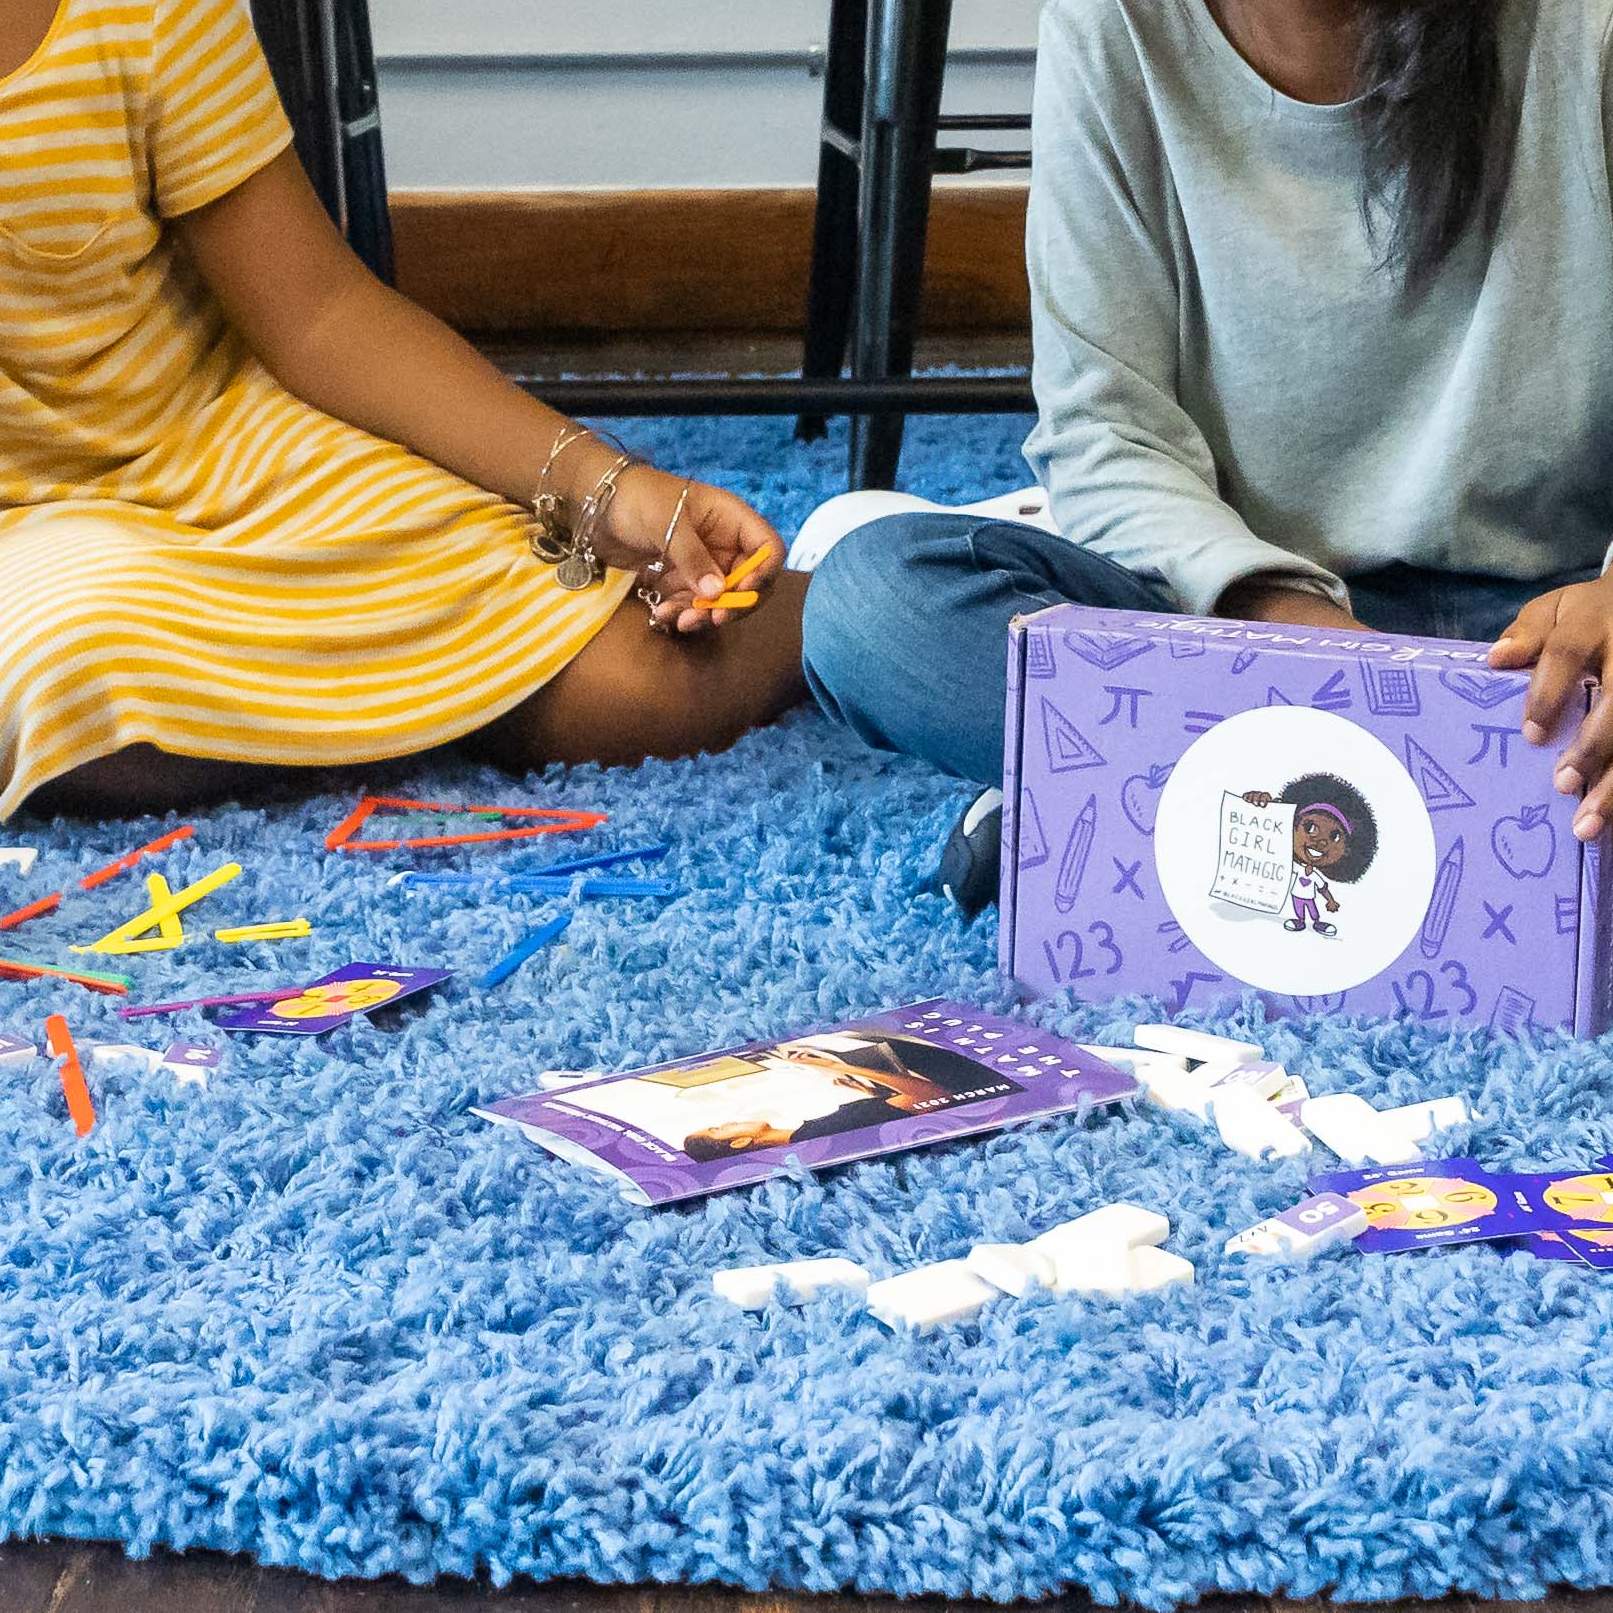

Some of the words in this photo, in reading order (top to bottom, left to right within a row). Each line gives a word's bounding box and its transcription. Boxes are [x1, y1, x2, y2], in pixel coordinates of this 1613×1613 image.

[1229, 811, 1283, 834] BLACK
[1229, 827, 1276, 855] GIRL
[1223, 850, 1285, 882] MATHGIC
[1043, 920, 1123, 983] 123
[904, 1021, 940, 1034] IS
[954, 1037, 1043, 1077] MATH
[1017, 1045, 1082, 1079] THE
[912, 1096, 950, 1111] 2021
[953, 1083, 1012, 1101] MARCH
[1299, 1199, 1340, 1224] 50
